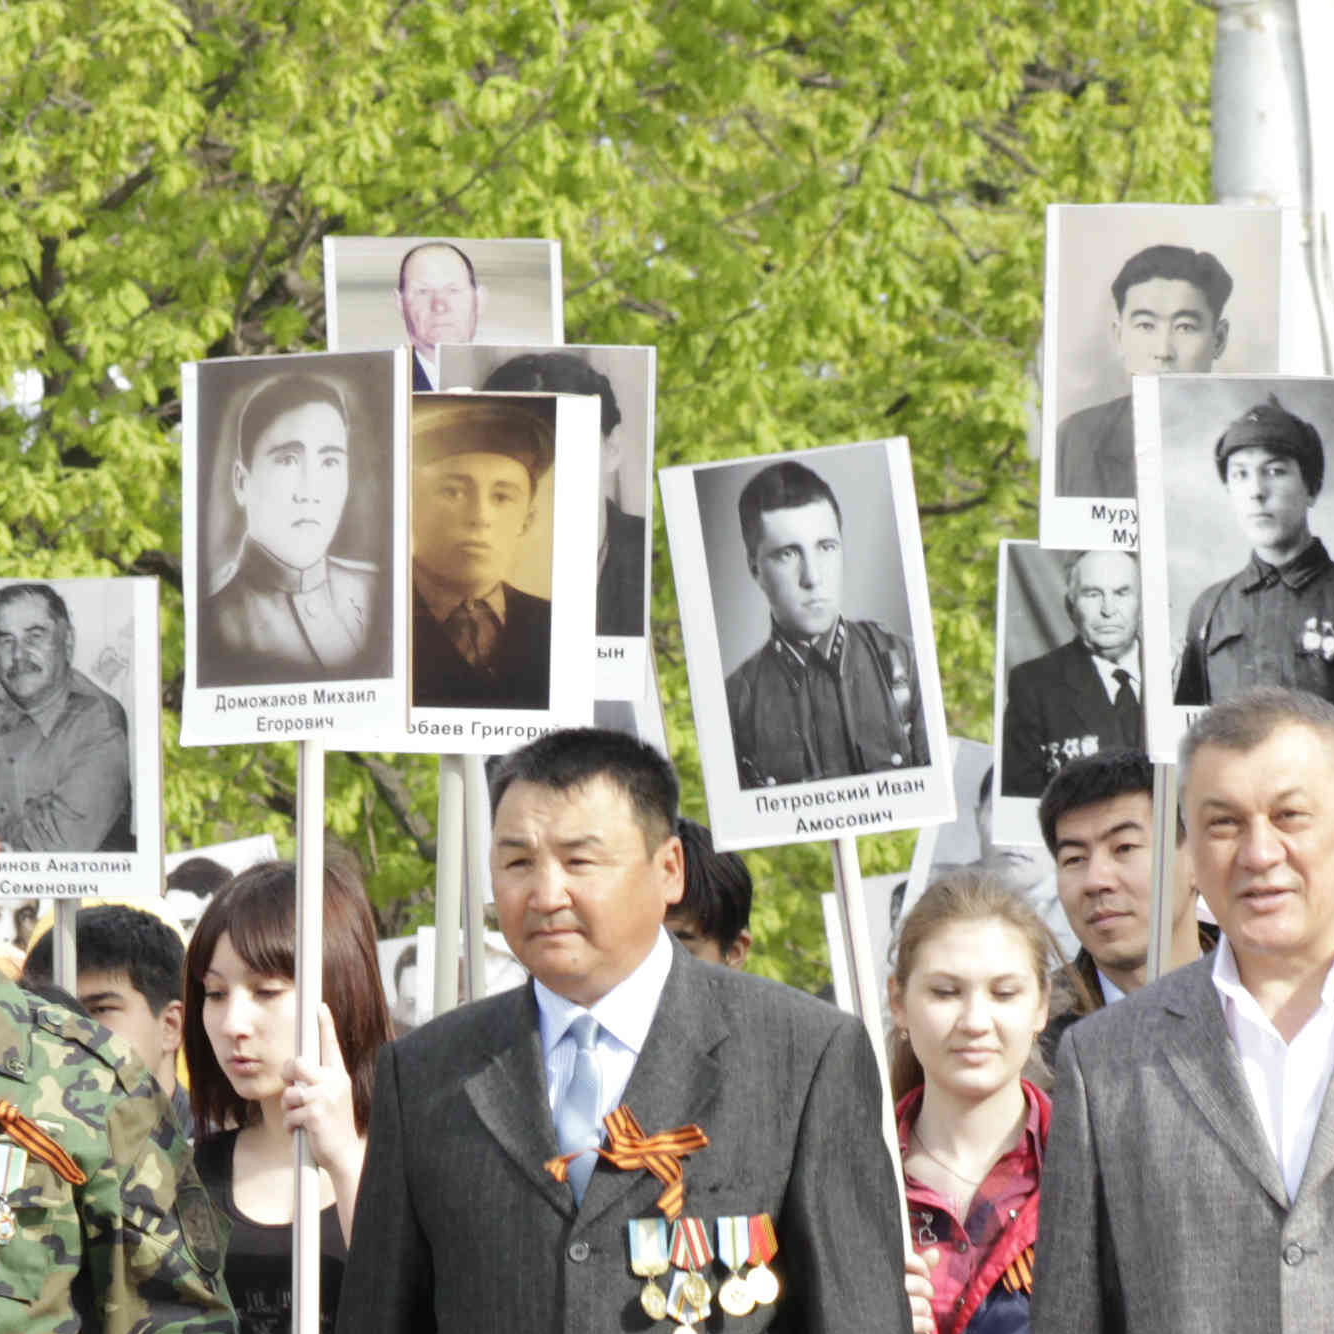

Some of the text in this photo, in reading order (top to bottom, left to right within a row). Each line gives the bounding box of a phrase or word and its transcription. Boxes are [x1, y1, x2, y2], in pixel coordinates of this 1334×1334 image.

[215, 689, 376, 713] Доможаков Михаил
[256, 716, 334, 734] Егорович
[755, 778, 925, 813] Петровский Иван
[795, 809, 893, 834] Амосович
[47, 857, 132, 873] Анатолий
[0, 879, 98, 895] Семенович
